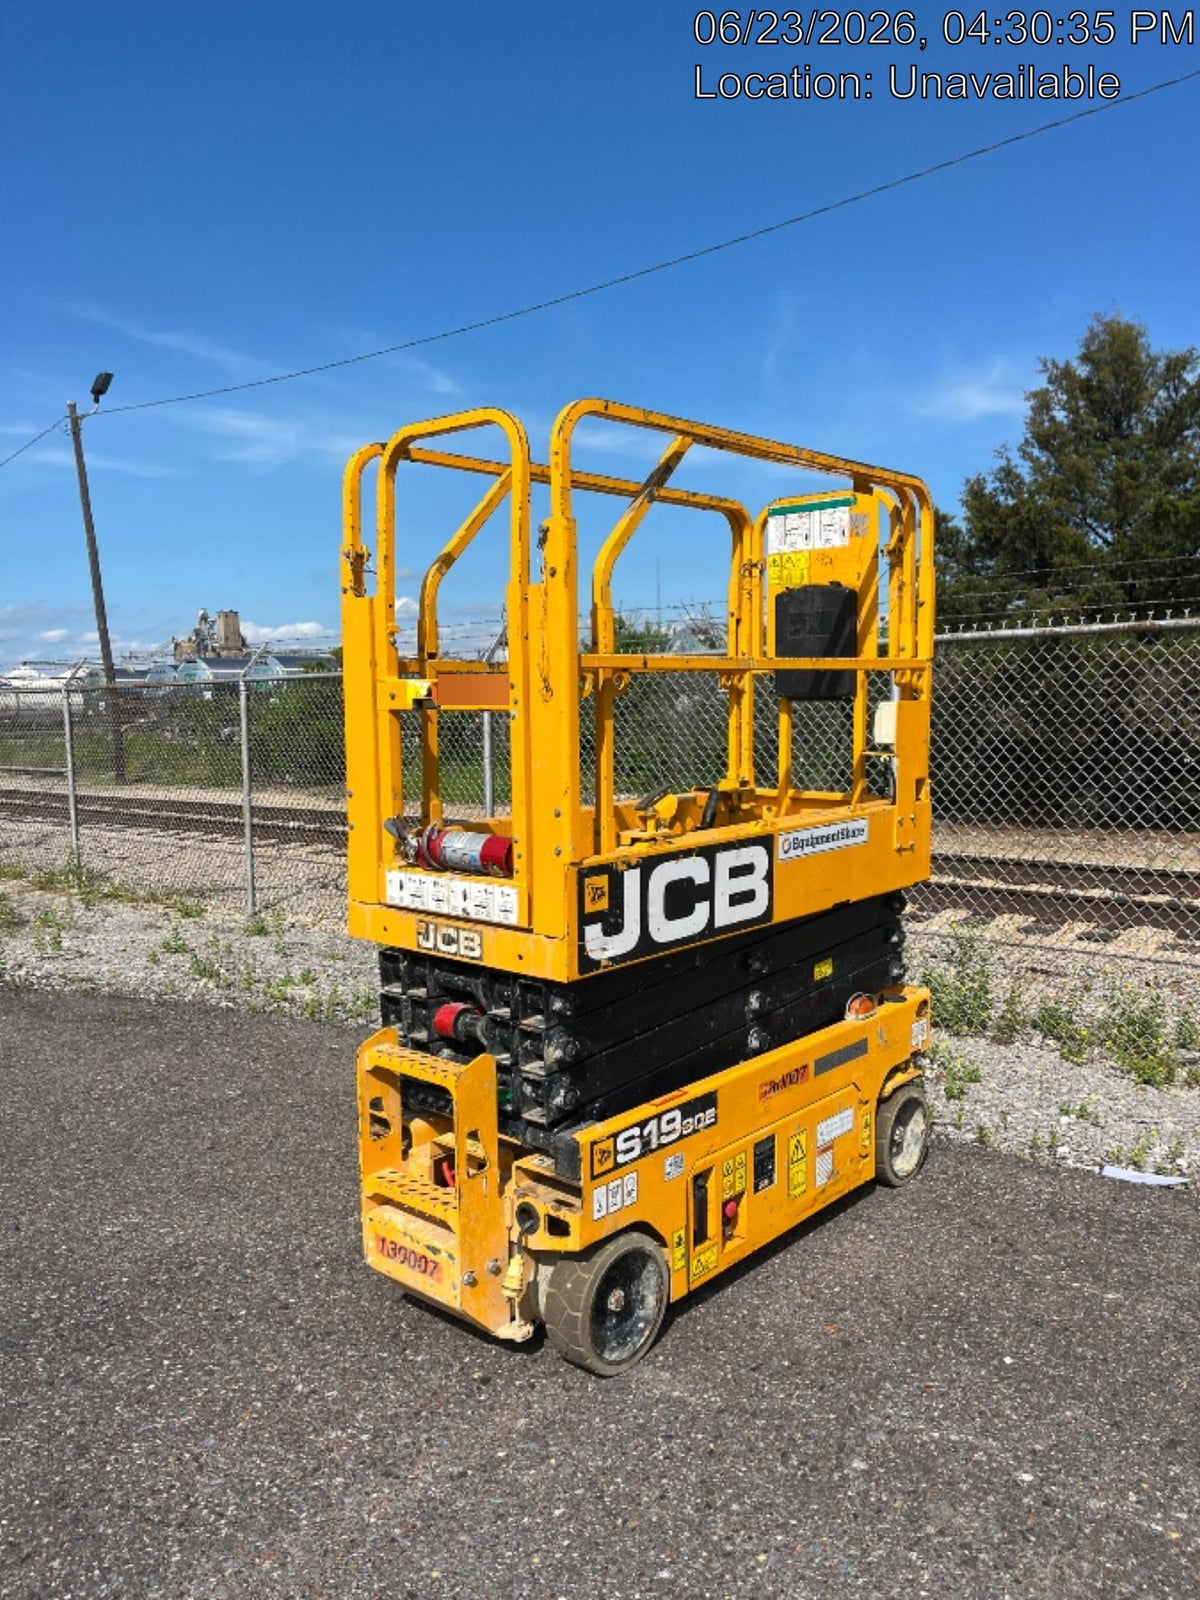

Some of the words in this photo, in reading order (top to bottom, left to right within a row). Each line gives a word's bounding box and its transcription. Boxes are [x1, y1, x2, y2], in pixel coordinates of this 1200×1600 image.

[792, 826, 865, 851] EquipmentShare
[584, 845, 769, 961] JCB
[417, 920, 483, 961] JCB
